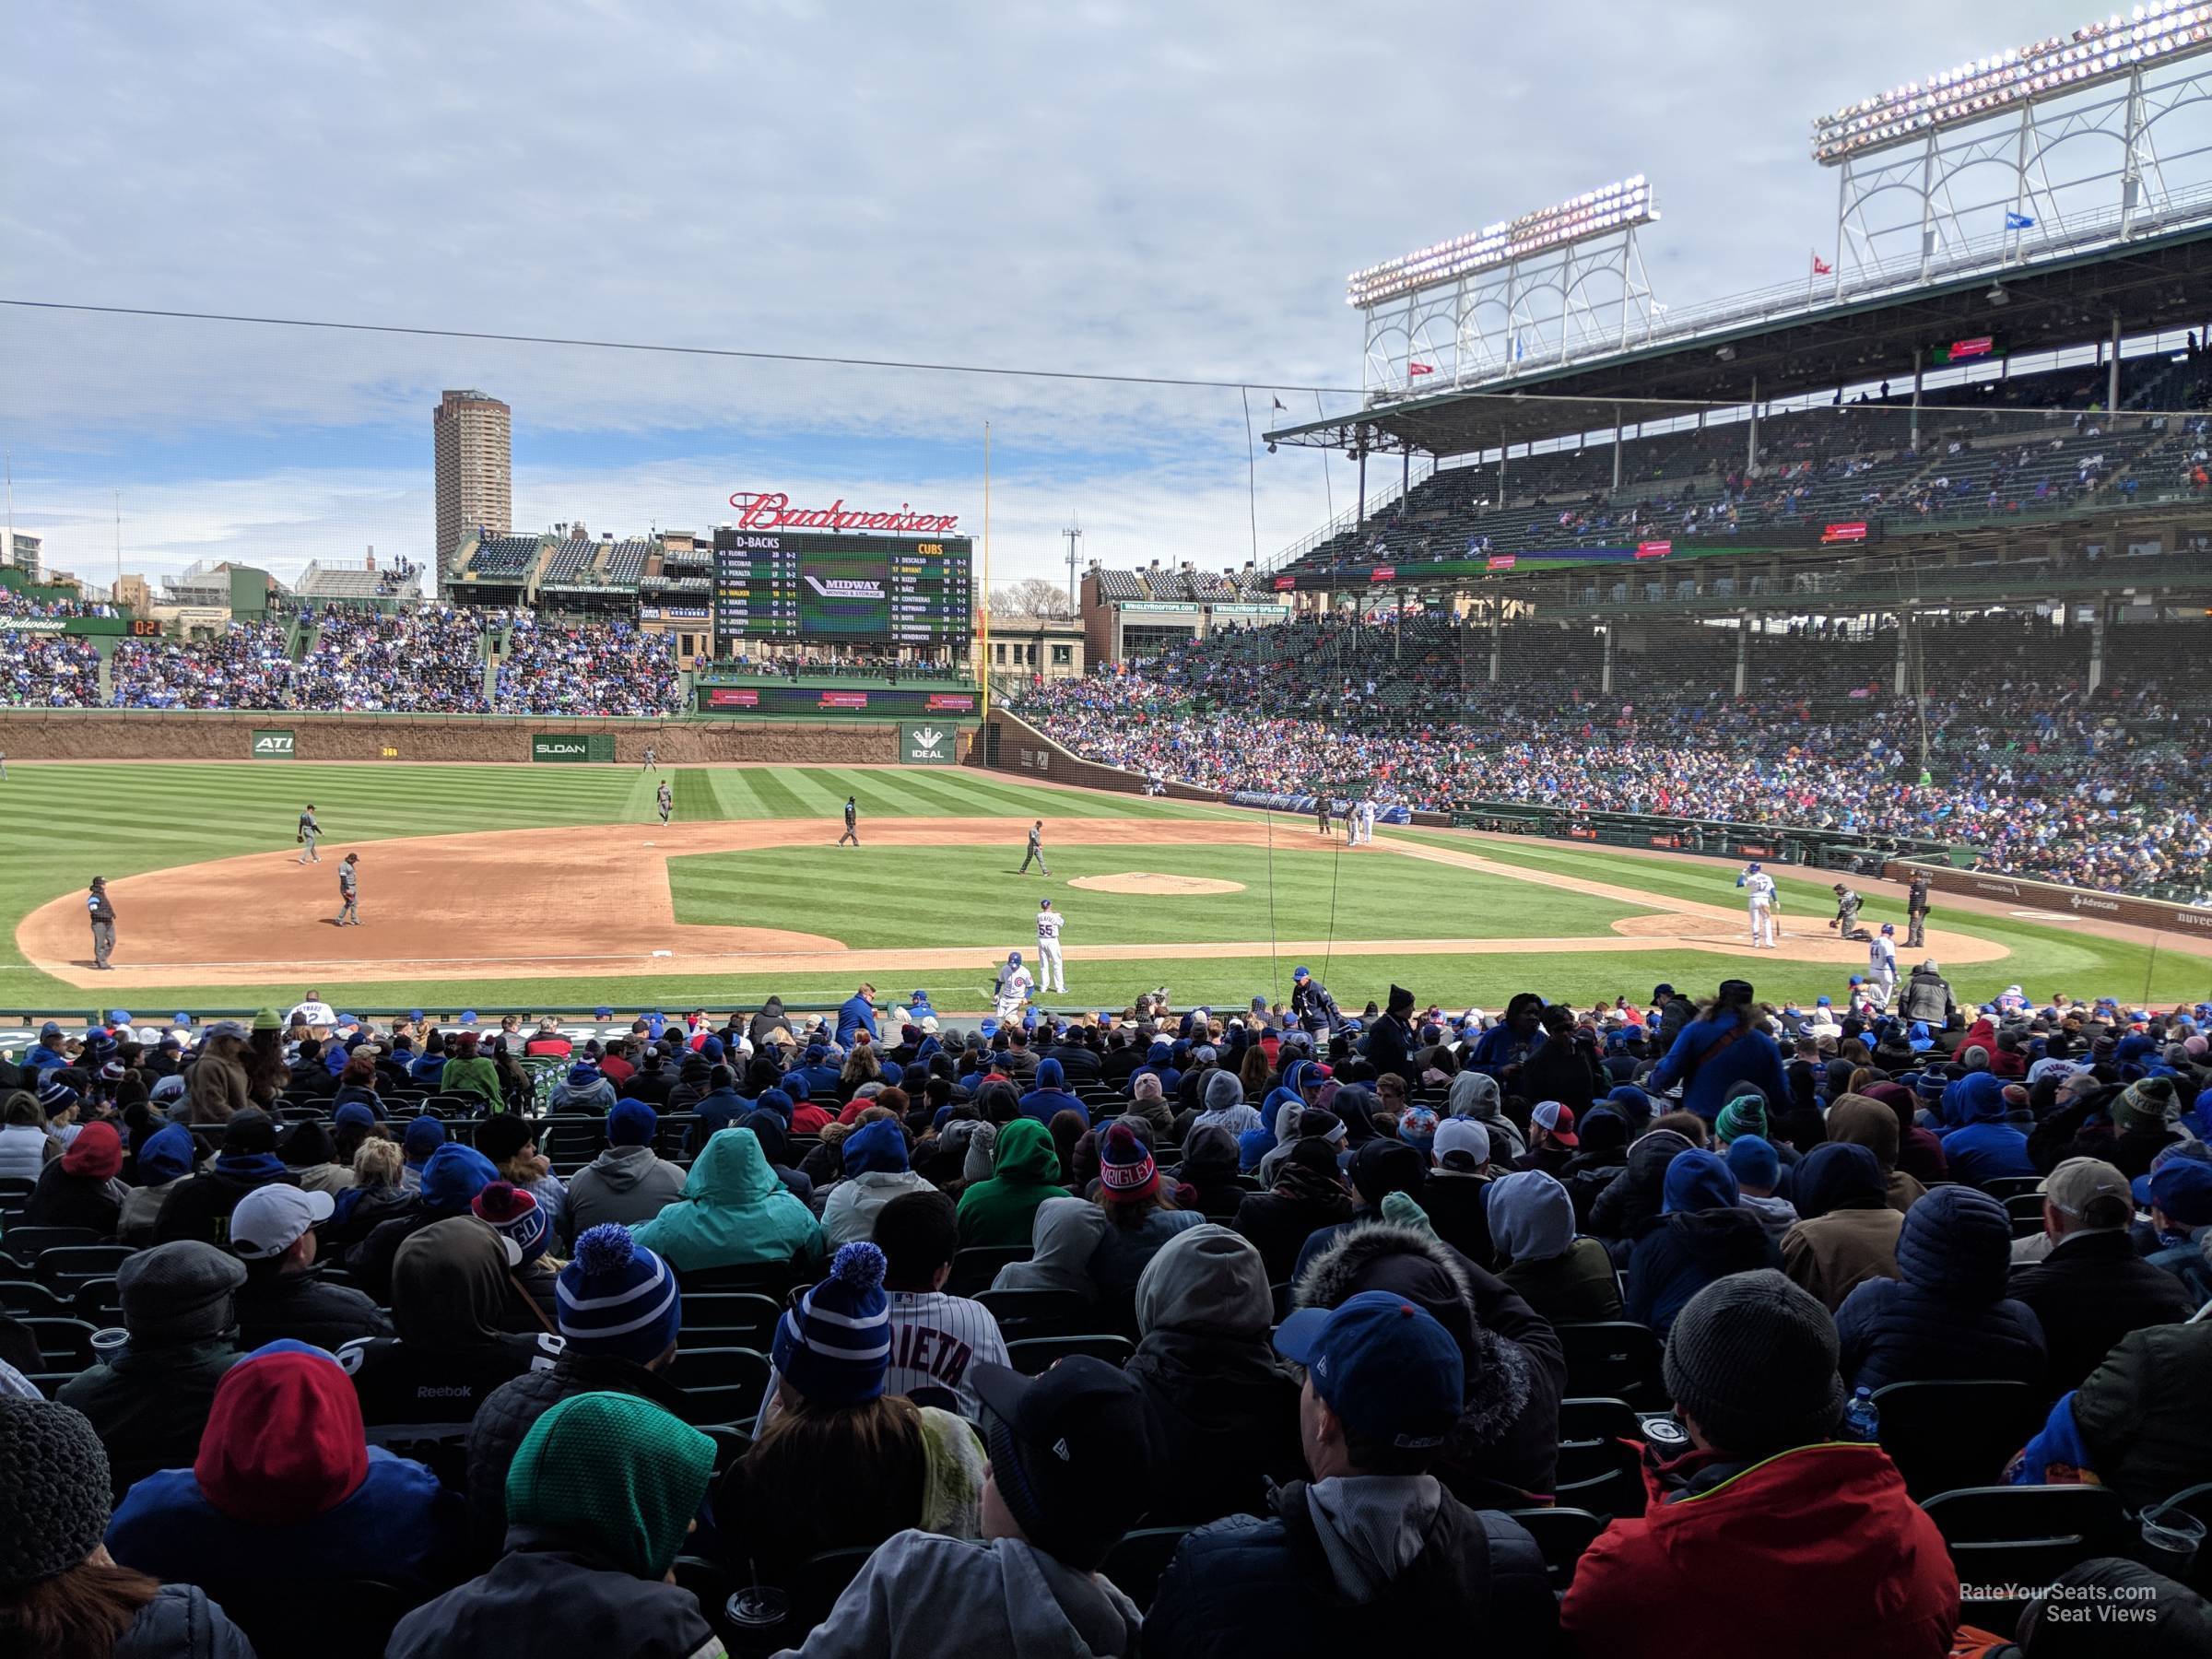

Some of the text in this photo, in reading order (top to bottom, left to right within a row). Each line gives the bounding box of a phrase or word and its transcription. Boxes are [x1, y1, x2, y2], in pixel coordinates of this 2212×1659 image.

[729, 492, 959, 532] Budweiser
[737, 536, 780, 548] D-BACKS
[918, 544, 943, 555] CUBS
[826, 580, 880, 590] MIDWAY
[1124, 603, 1194, 611] WRIGLEYROOFTOPS.COM
[0, 616, 66, 630] Budweiser
[256, 737, 293, 748] ATI
[536, 745, 585, 753] SLOAN
[912, 750, 944, 759] IDEAL
[1757, 881, 1769, 892] 17
[2083, 898, 2119, 911] Advocate
[1038, 924, 1053, 936] 55
[1871, 946, 1880, 959] 44
[1101, 1160, 1150, 1185] WRIGLEY
[418, 1386, 472, 1399] Reebok
